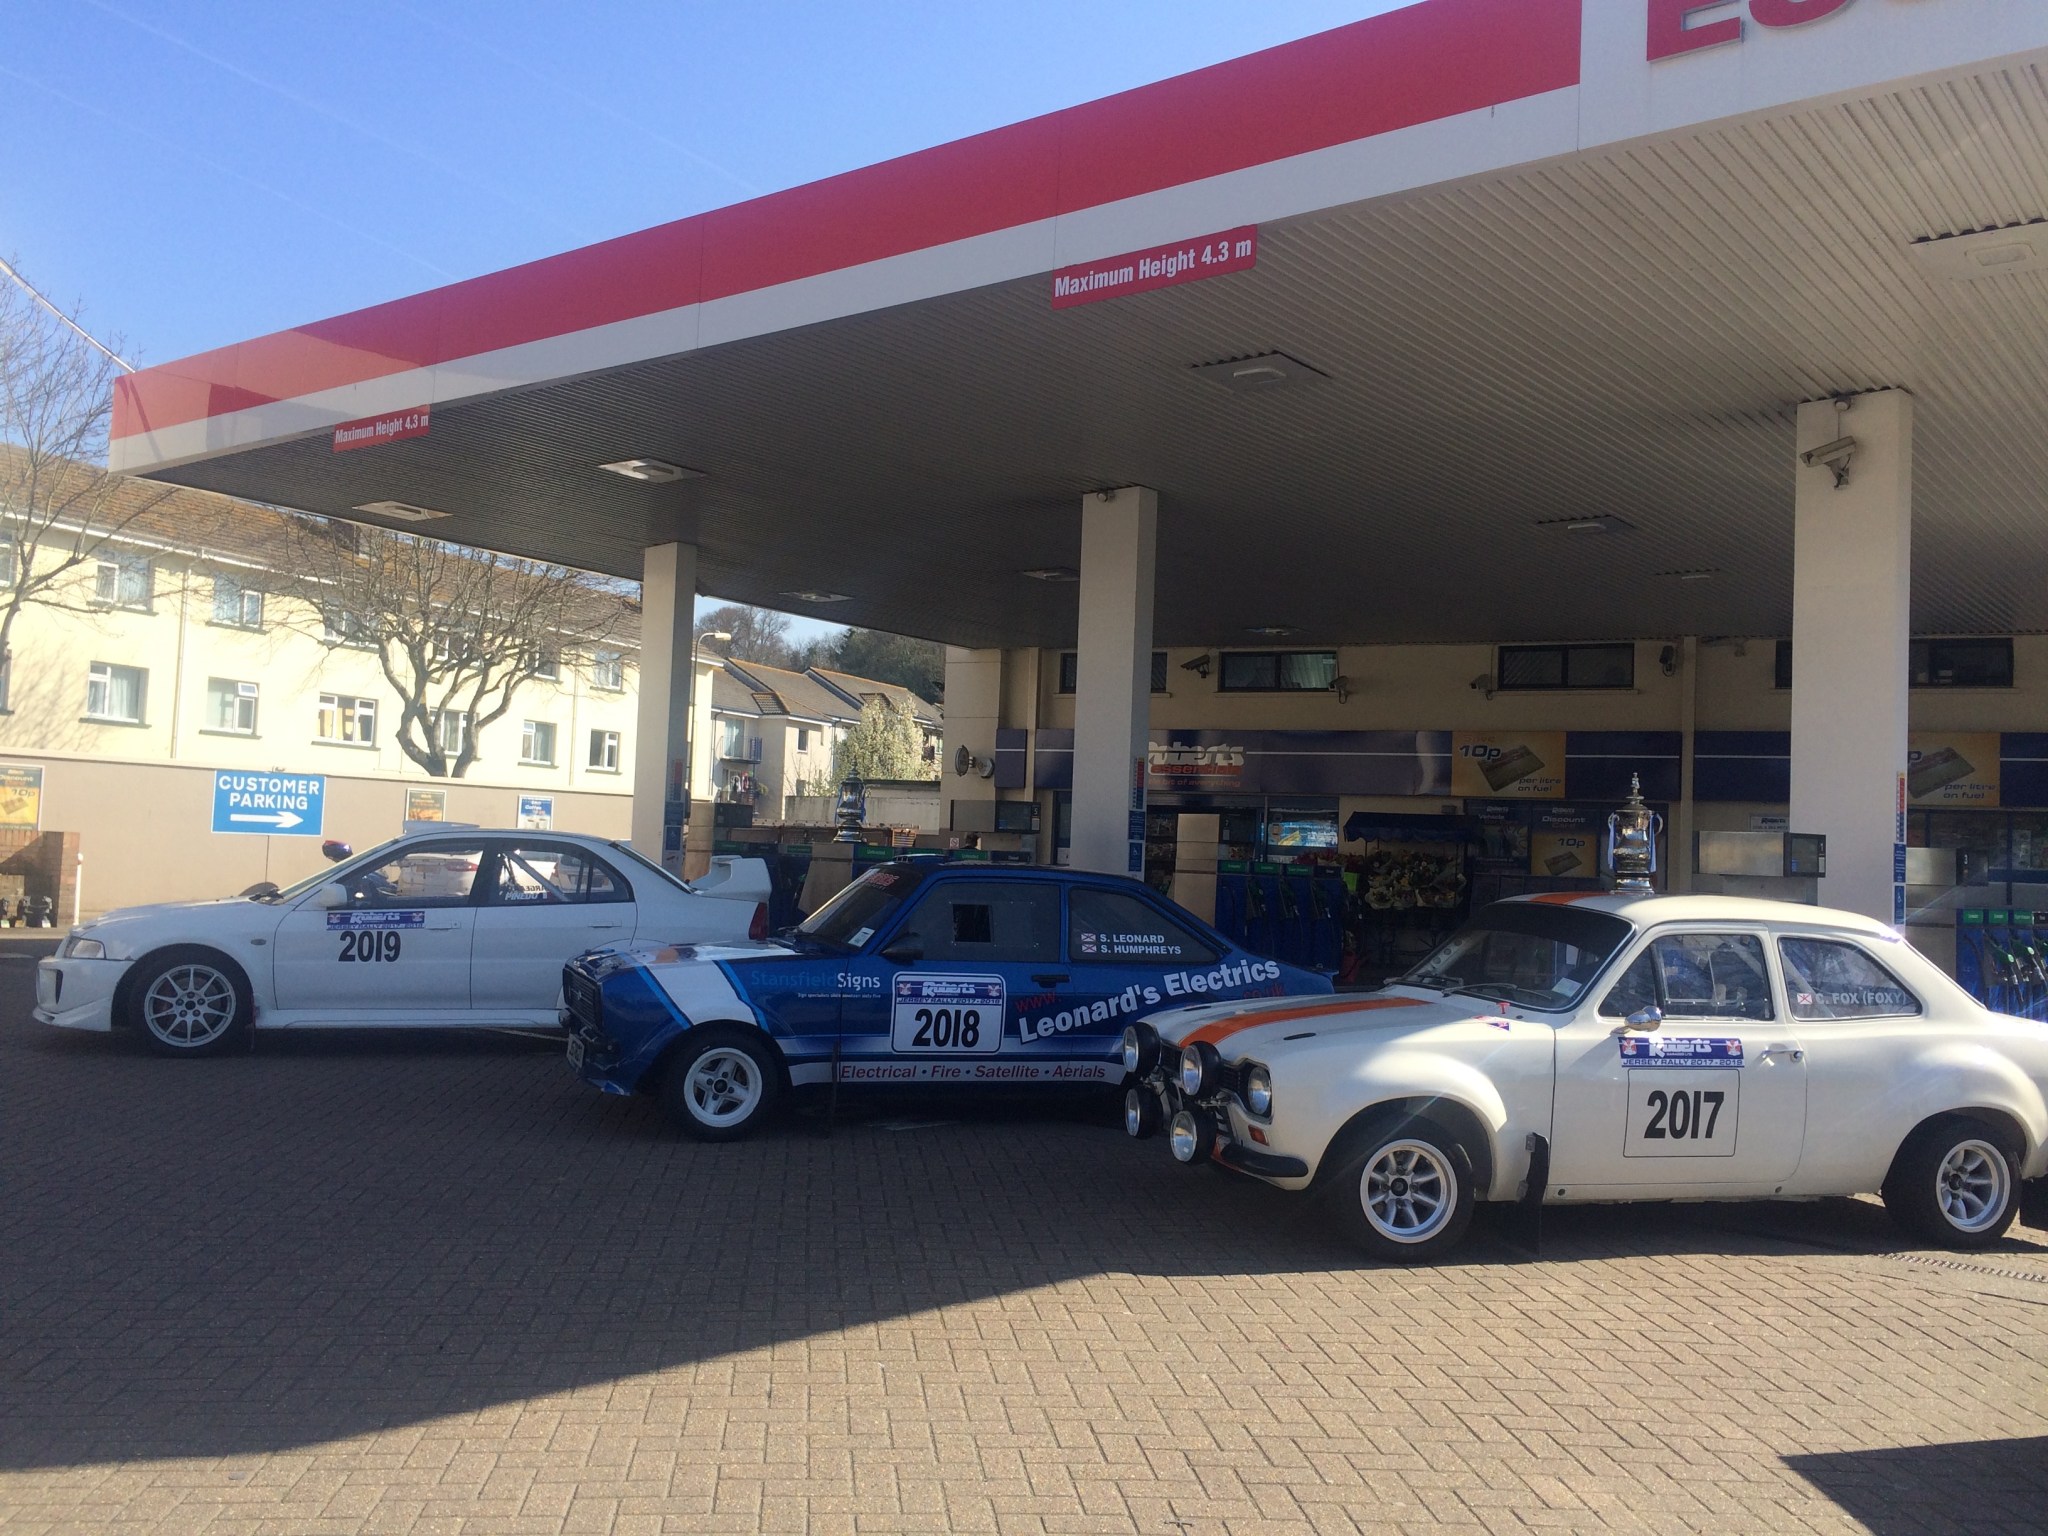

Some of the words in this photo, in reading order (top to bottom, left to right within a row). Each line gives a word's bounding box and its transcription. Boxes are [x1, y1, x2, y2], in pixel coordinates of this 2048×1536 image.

[1054, 267, 1134, 298] Maximum
[1138, 248, 1196, 280] Height
[1201, 241, 1229, 265] 4.3
[1235, 239, 1252, 258] m
[335, 426, 374, 444] Maximum
[375, 417, 403, 437] Height
[404, 414, 418, 430] 4.3
[420, 415, 429, 427] m
[1459, 744, 1502, 760] 10p
[219, 775, 320, 795] CUSTOMER
[1518, 777, 1537, 785] per
[1539, 776, 1562, 784] litre
[1533, 784, 1552, 792] fuel
[1944, 783, 1967, 791] per
[1969, 782, 1996, 790] litre
[229, 793, 308, 810] PARKING
[1541, 815, 1587, 823] Discount
[1557, 838, 1586, 848] 10p
[338, 930, 401, 962] 2019
[1099, 933, 1110, 943] S.
[1112, 934, 1165, 943] LEONARD
[1100, 944, 1112, 953] S.
[1114, 945, 1182, 954] HUMPHREYS
[837, 972, 881, 991] Signs
[922, 981, 976, 997] Roberts
[1018, 983, 1161, 1044] Leonard's
[1163, 959, 1281, 998] Electrics
[1832, 992, 1860, 1004] FOX
[1862, 991, 1906, 1006] (FOXY)
[911, 1008, 980, 1048] 2018
[1648, 1037, 1712, 1058] Roberts
[840, 1064, 917, 1079] Electrical
[930, 1065, 961, 1078] Fire
[974, 1065, 1039, 1079] Satellite
[1052, 1065, 1105, 1079] Aerials
[1643, 1089, 1725, 1139] 2017
